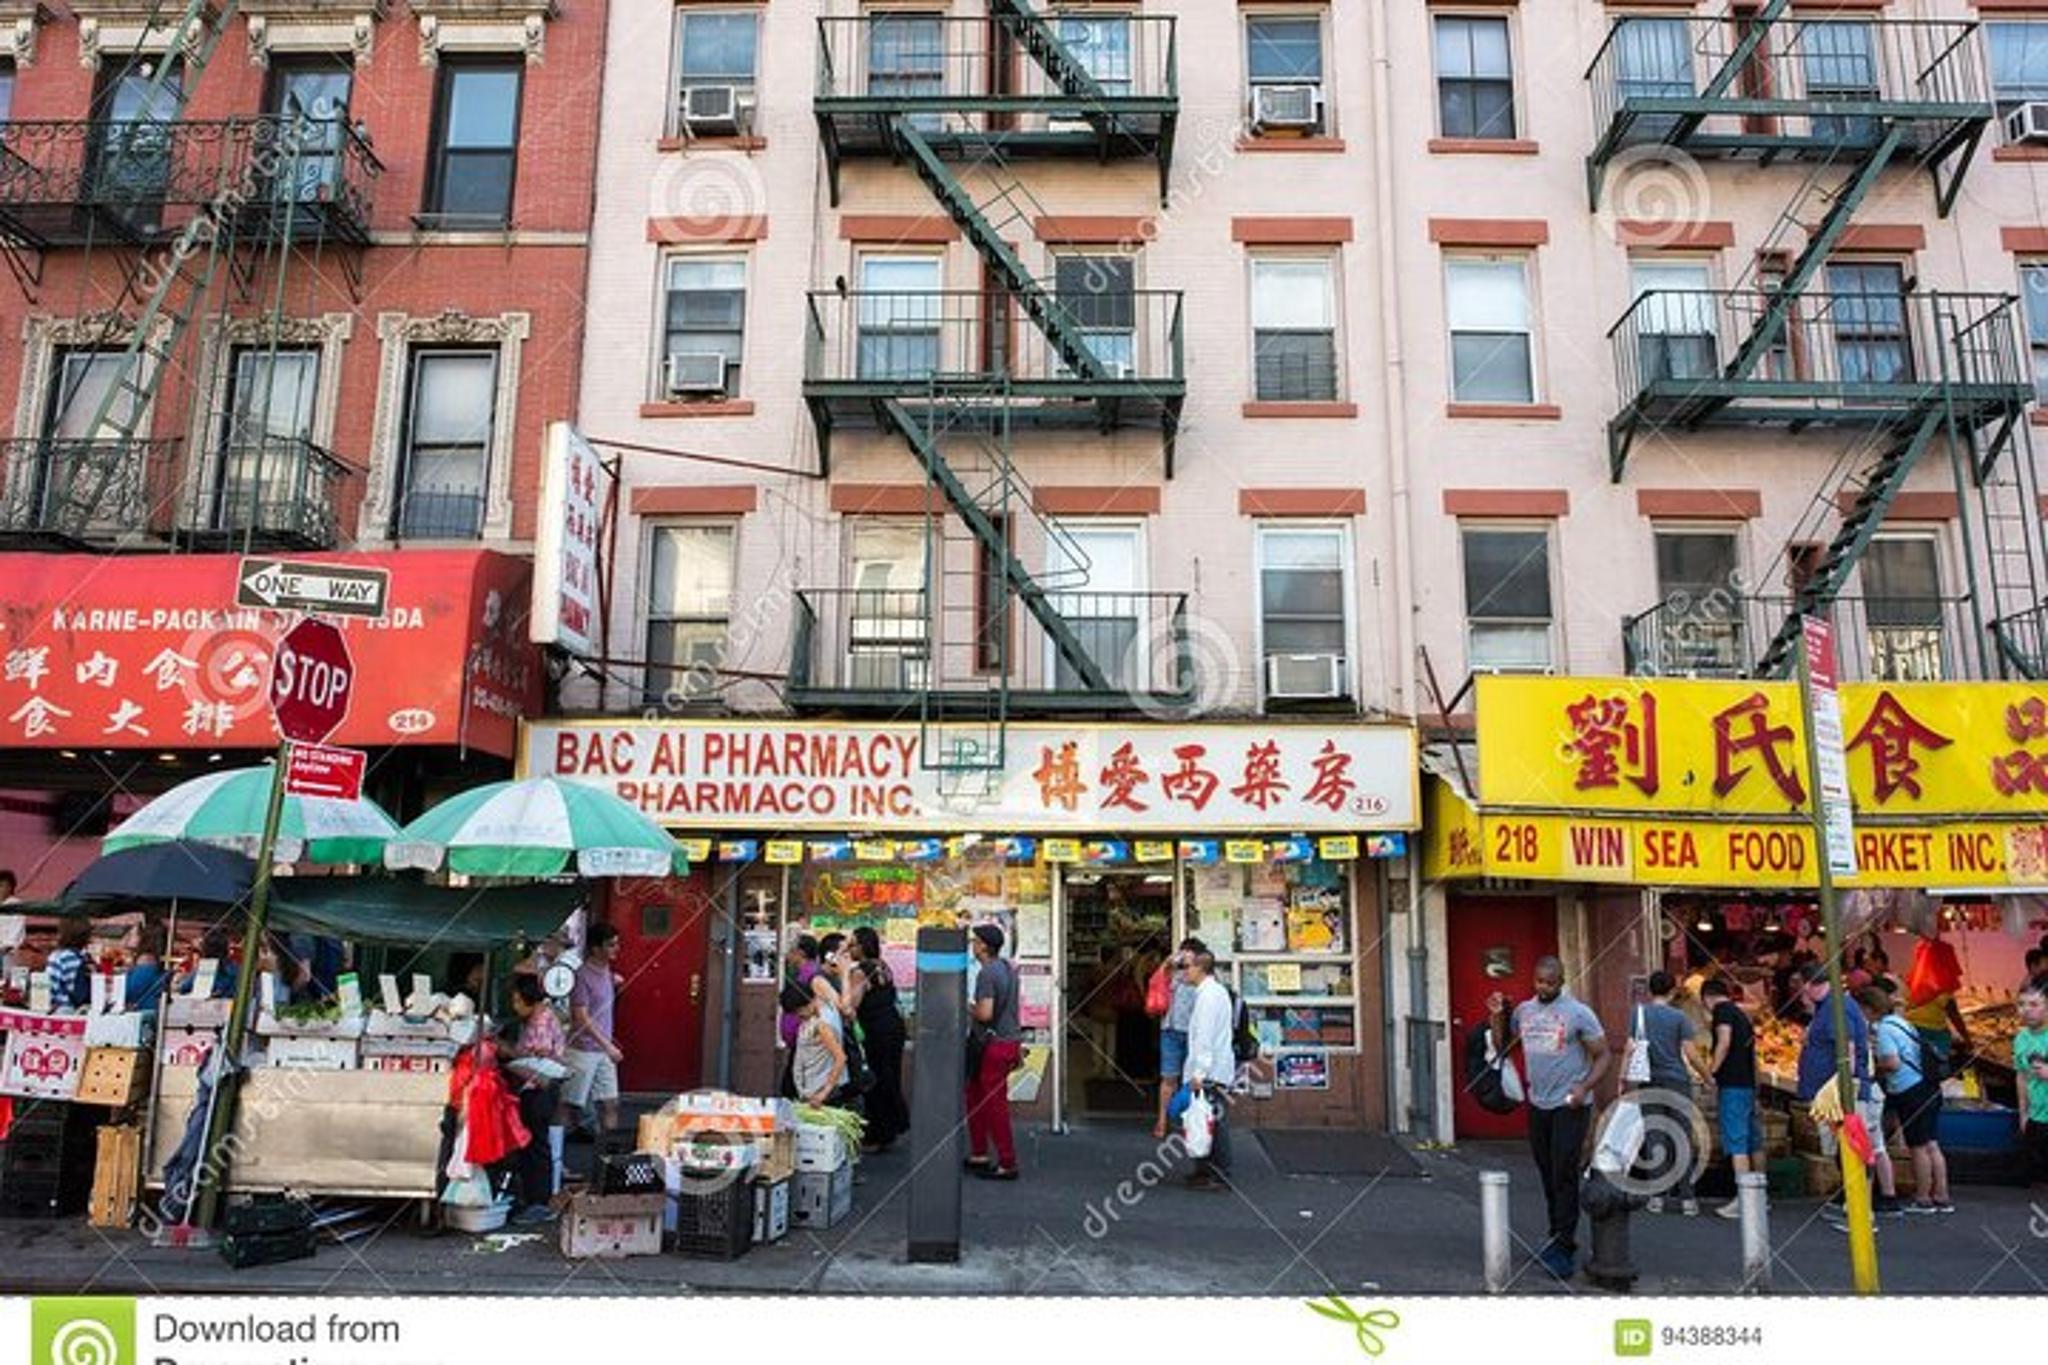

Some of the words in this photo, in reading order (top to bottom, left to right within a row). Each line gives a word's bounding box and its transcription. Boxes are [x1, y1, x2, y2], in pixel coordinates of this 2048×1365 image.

[255, 574, 302, 595] ONE
[328, 580, 373, 600] WAY
[275, 652, 348, 710] STOP
[8, 696, 282, 738] 食大排
[556, 731, 634, 774] BAC
[651, 733, 685, 775] AI
[704, 733, 918, 777] PHARMACY
[1032, 738, 1357, 814] 博愛西藥房
[617, 782, 835, 815] PHARMACO
[850, 784, 921, 817] INC.
[1356, 799, 1382, 812] 216
[1496, 824, 1538, 863] 218
[1571, 826, 1625, 867] WIN
[1644, 830, 1698, 868] SEA
[1728, 832, 1805, 872] FOOD
[1854, 832, 1933, 872] RKET
[1948, 833, 2007, 872] INC.
